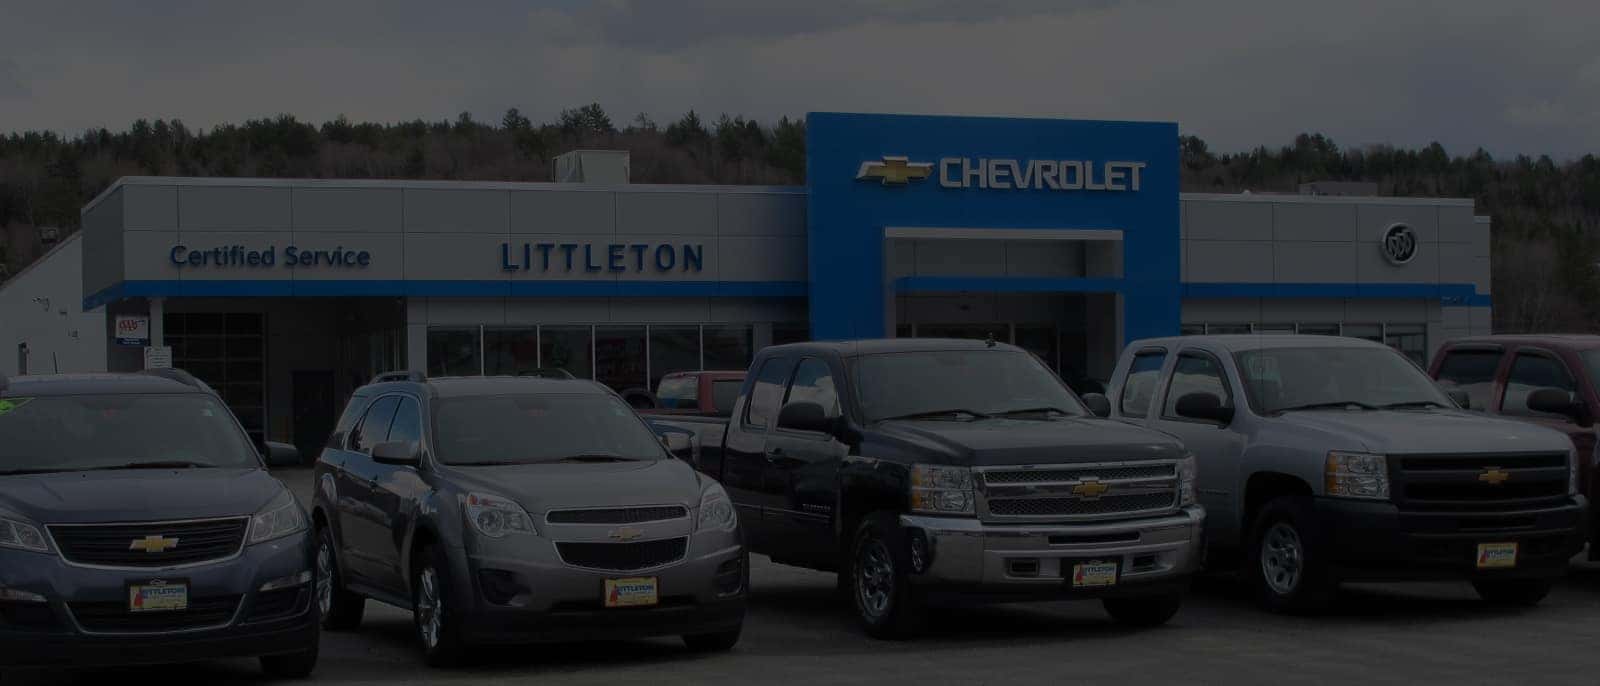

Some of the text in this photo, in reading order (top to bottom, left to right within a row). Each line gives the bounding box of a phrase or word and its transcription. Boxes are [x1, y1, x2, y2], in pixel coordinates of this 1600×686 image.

[939, 157, 1147, 192] CHEVROLET
[170, 245, 370, 267] Certified Service
[501, 243, 704, 272] LITTLETON
